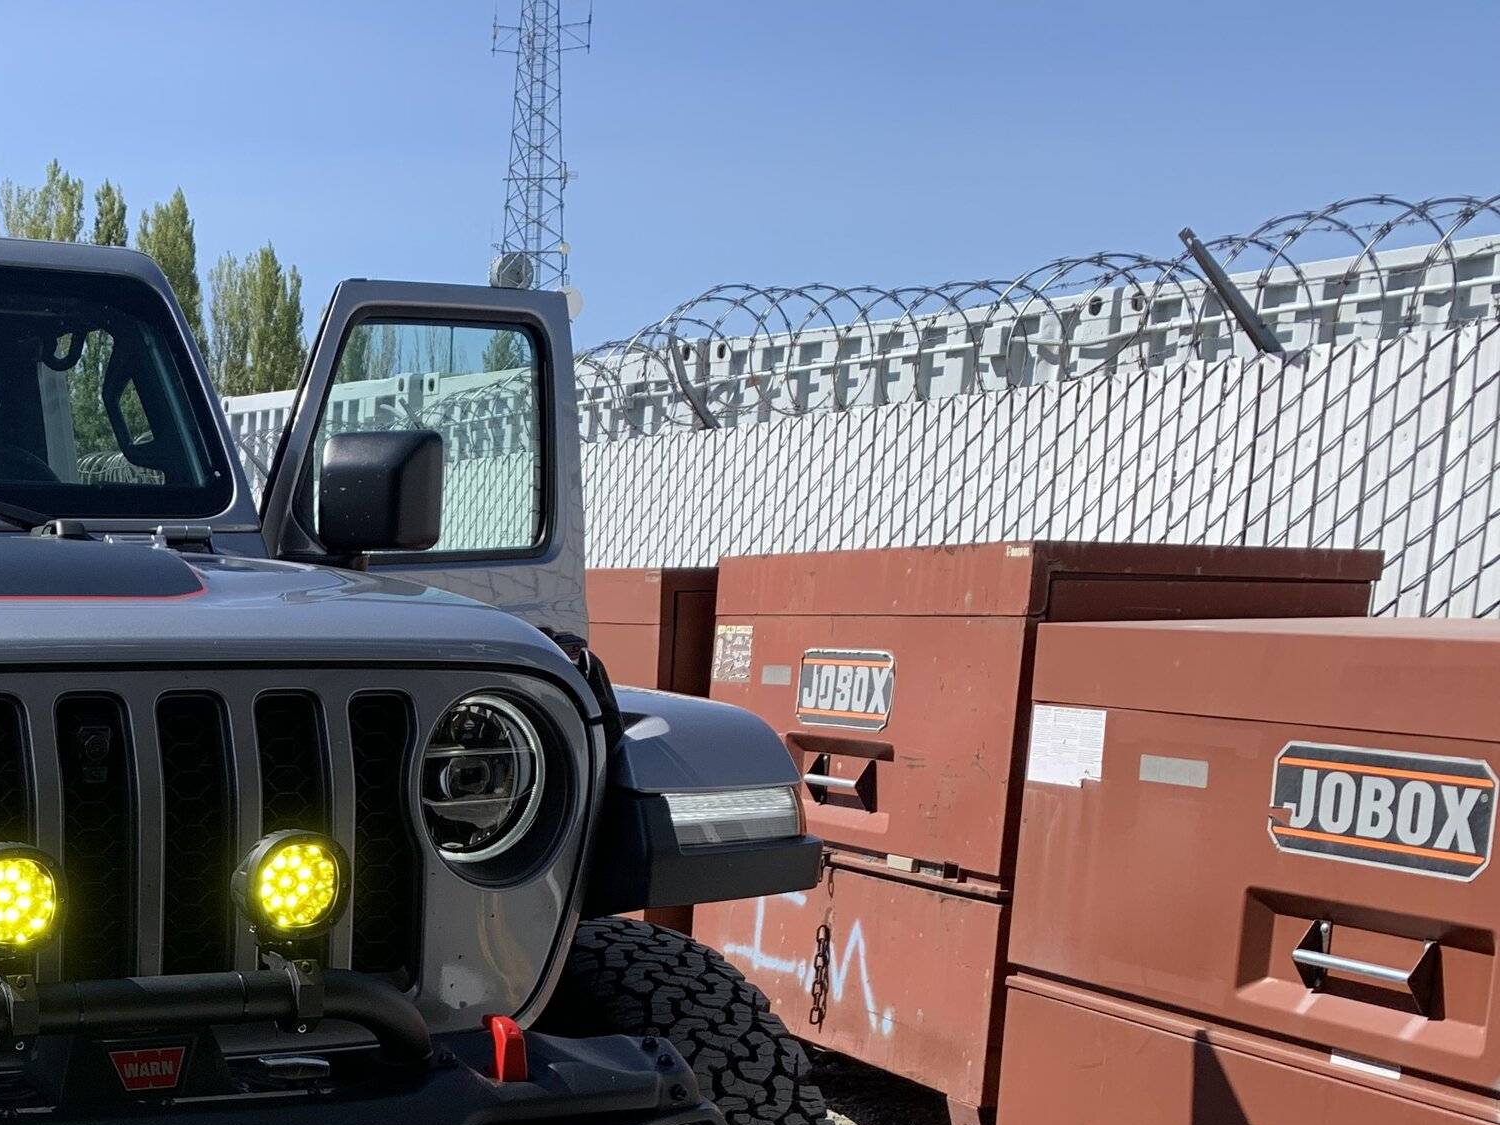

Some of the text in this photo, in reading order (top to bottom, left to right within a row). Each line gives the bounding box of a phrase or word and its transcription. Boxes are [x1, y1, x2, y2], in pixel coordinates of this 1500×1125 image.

[802, 665, 892, 713] JOBOX
[1284, 769, 1482, 854] JOBOX
[123, 1061, 174, 1078] WARN
